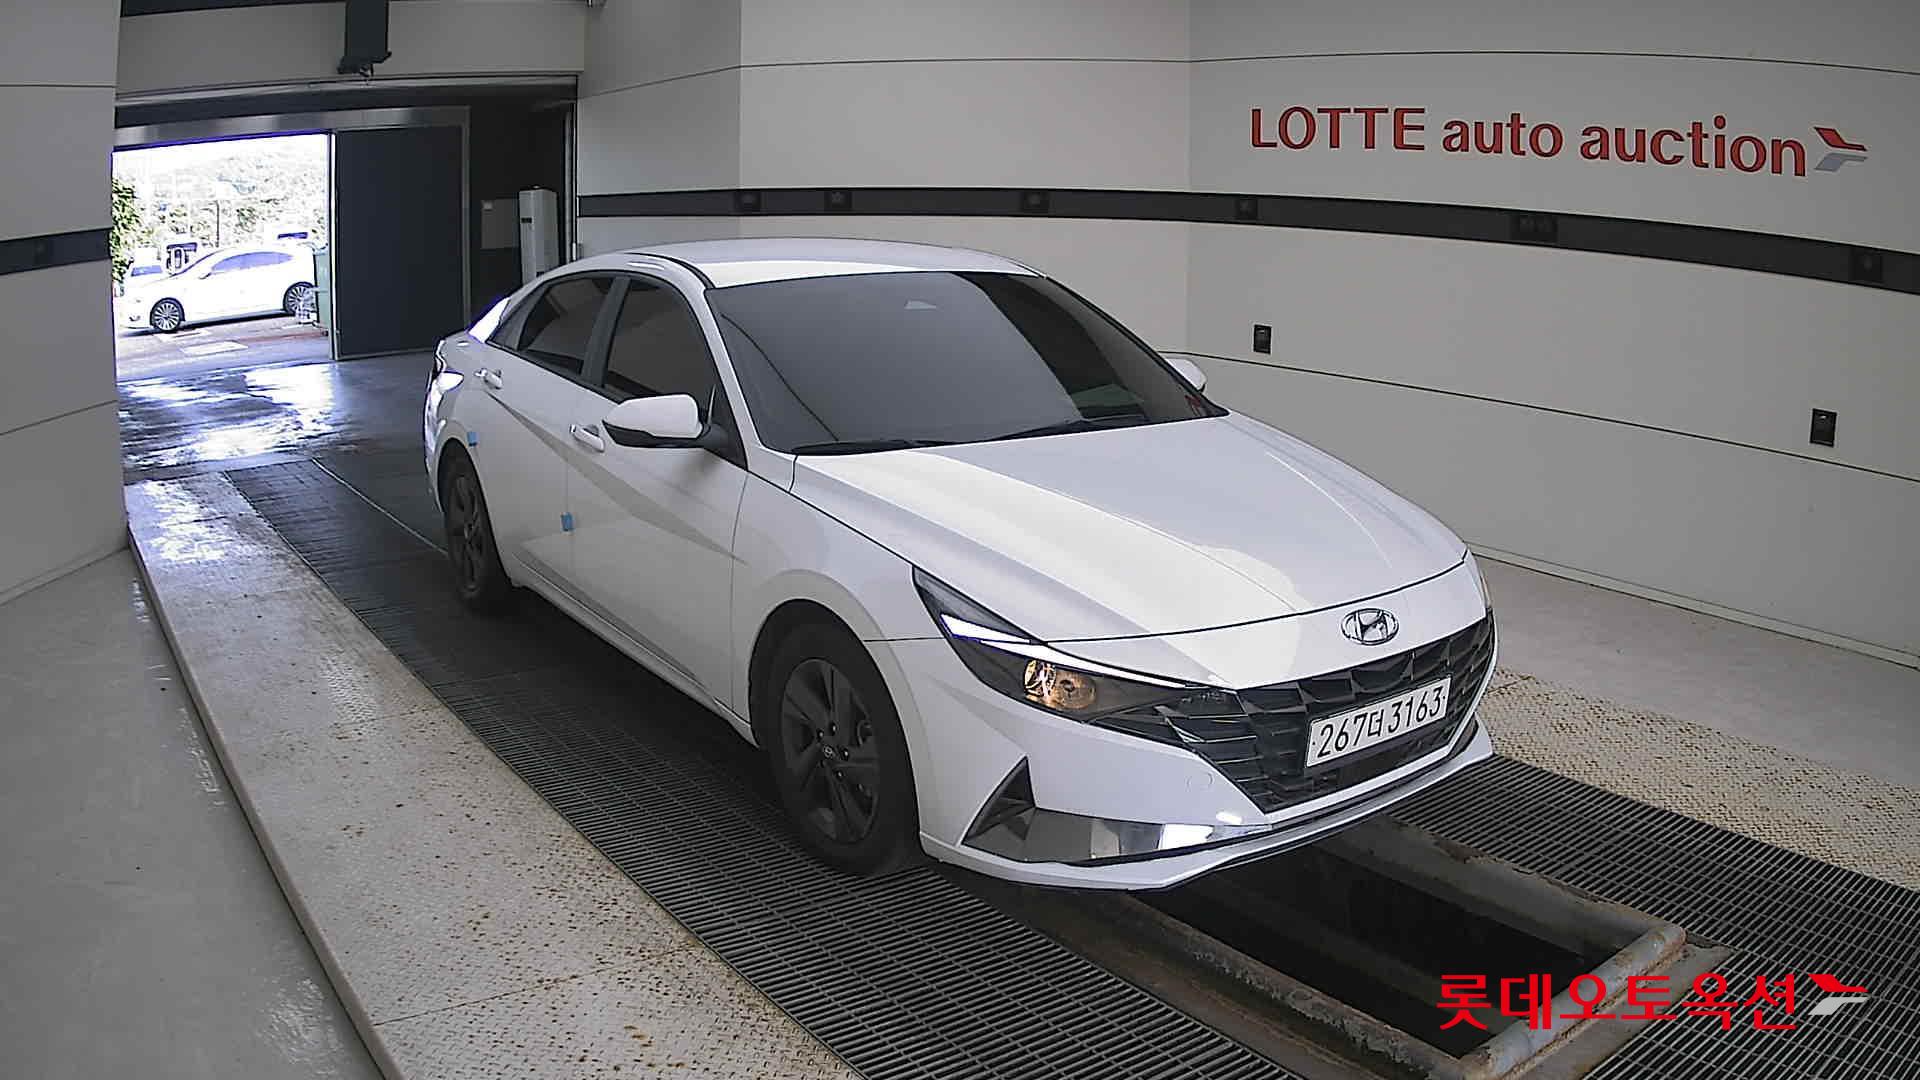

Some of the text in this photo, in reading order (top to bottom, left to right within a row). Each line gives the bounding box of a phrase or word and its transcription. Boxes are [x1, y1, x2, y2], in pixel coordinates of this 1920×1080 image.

[1251, 107, 1807, 177] LOTTE auto auction
